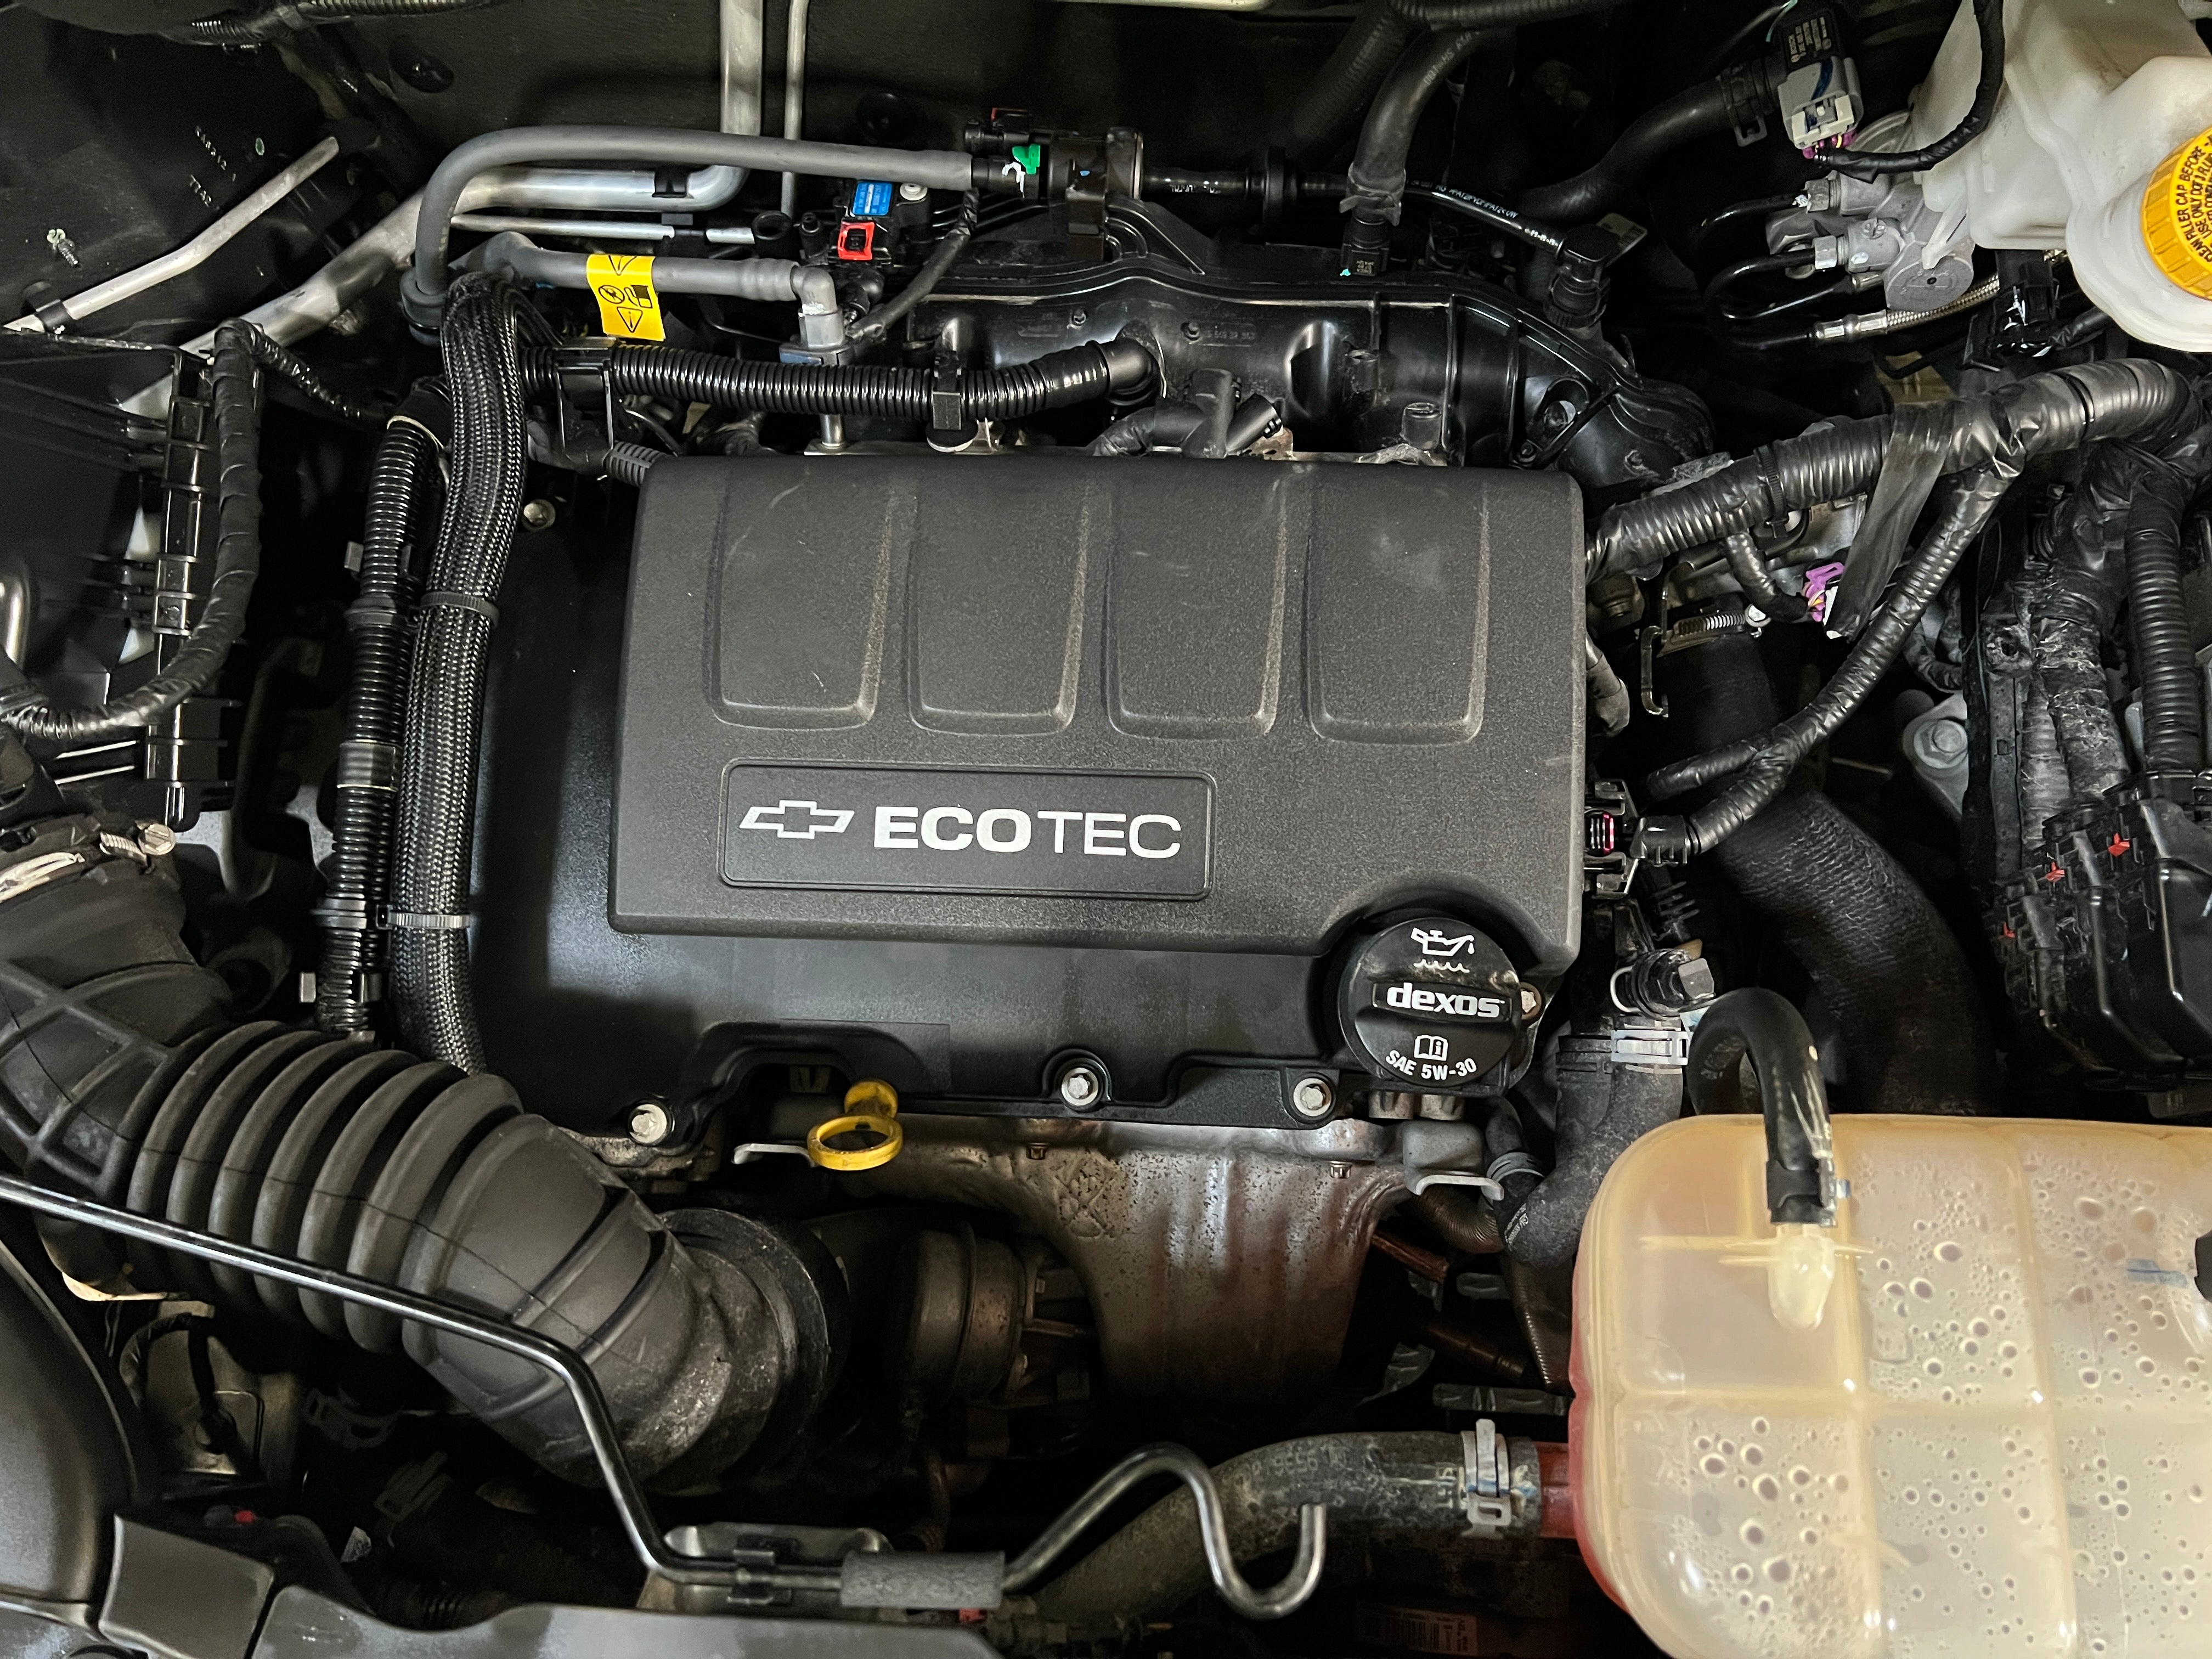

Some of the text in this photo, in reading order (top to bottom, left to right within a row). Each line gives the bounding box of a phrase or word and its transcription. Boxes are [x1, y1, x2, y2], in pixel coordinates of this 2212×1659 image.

[2179, 146, 2206, 182] BEFORE
[2176, 184, 2188, 205] CAP
[2191, 179, 2204, 195] DOT
[2191, 196, 2204, 218] ONLY
[2177, 208, 2198, 240] FILLER
[2194, 218, 2212, 239] USE
[873, 805, 1181, 859] ECOTEC
[1387, 982, 1500, 1018] dexos
[1385, 1049, 1477, 1080] SAE 5W-30
